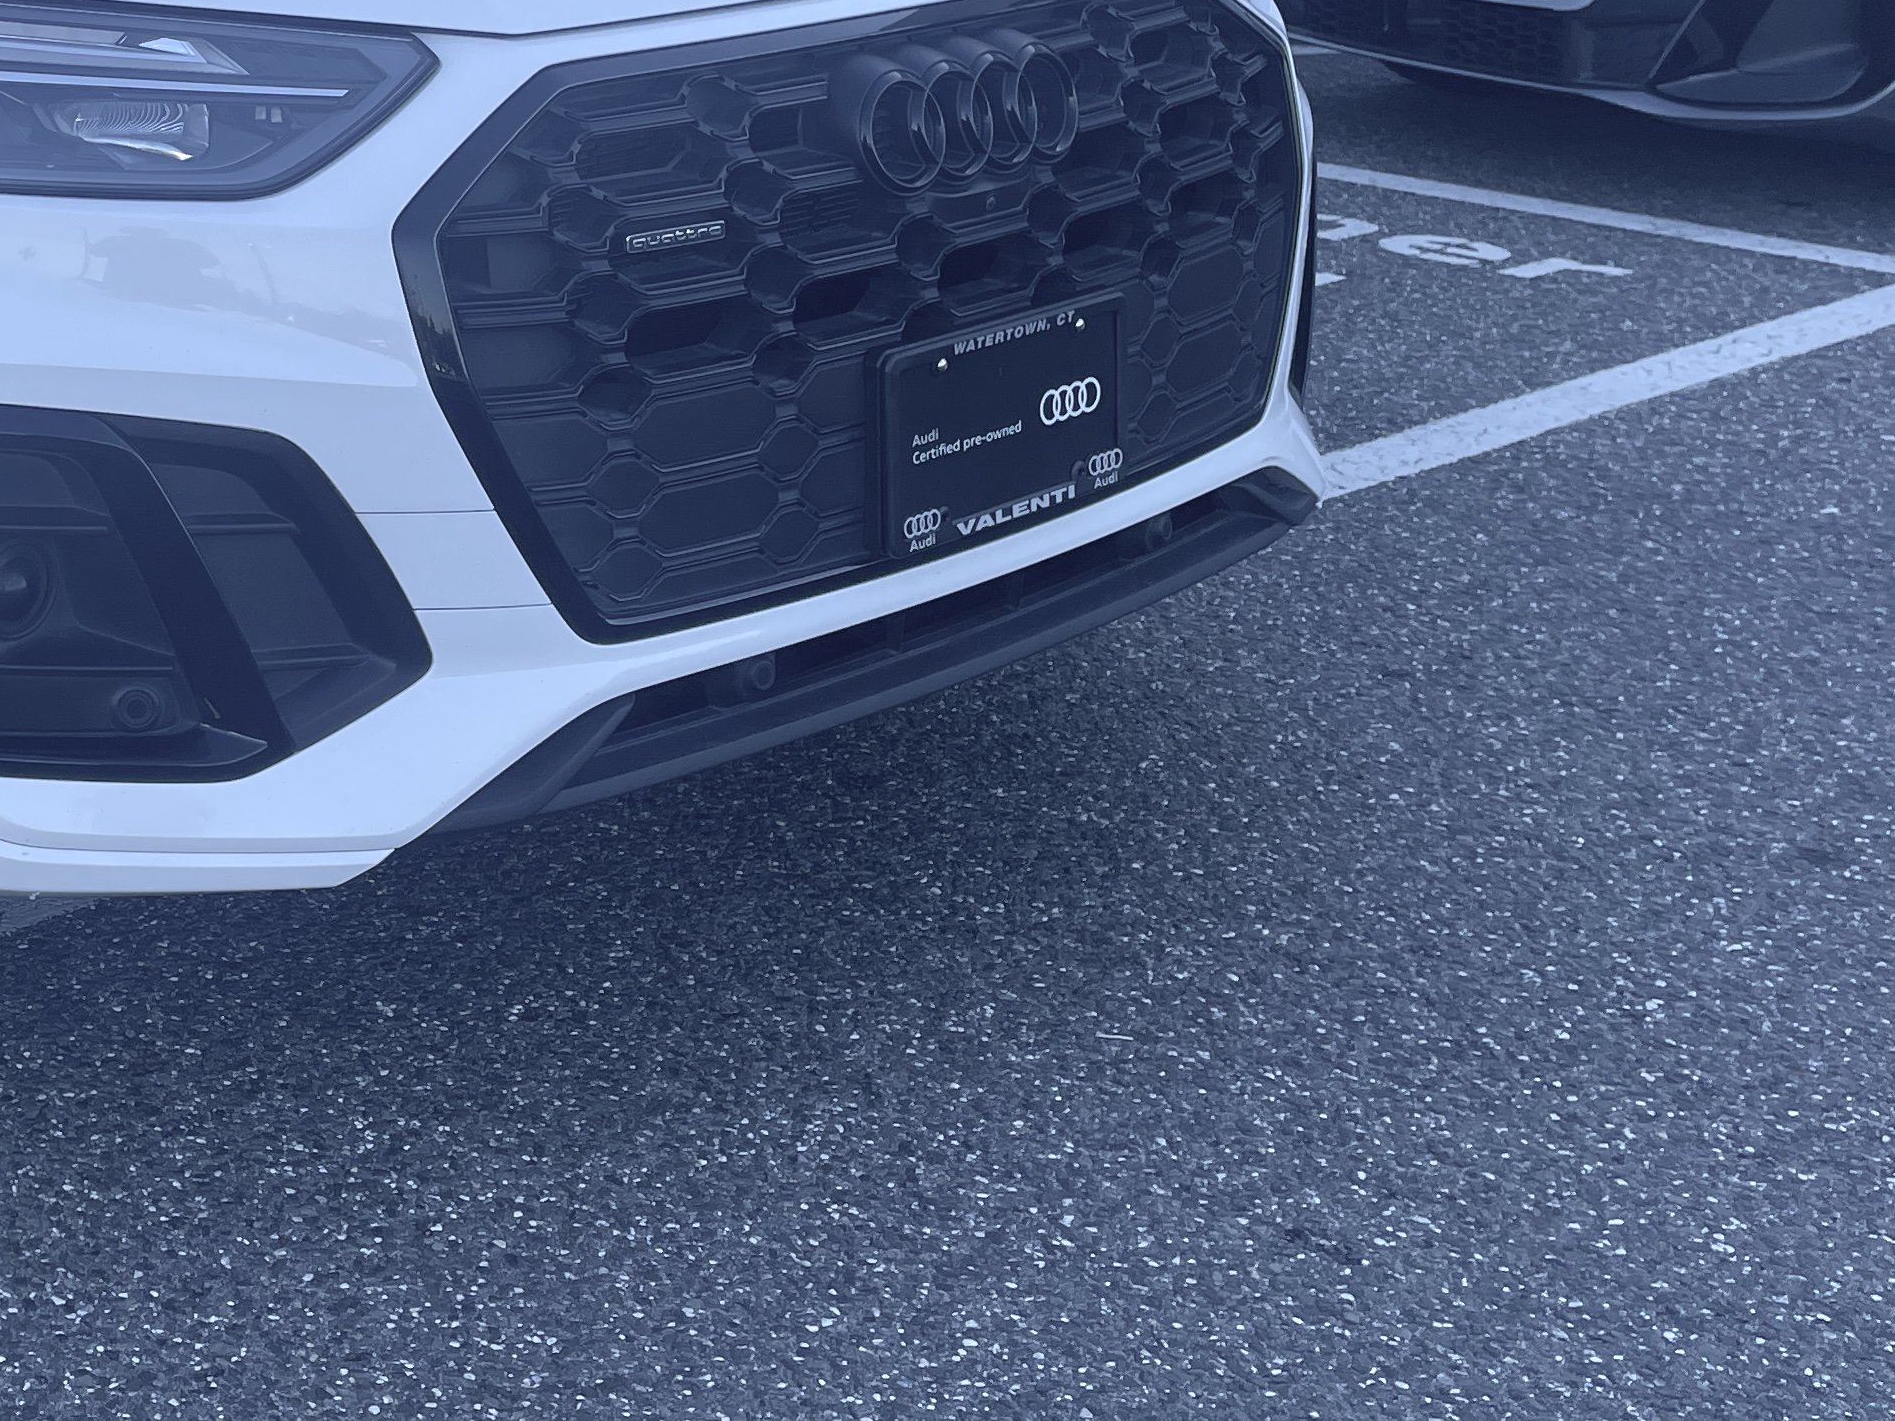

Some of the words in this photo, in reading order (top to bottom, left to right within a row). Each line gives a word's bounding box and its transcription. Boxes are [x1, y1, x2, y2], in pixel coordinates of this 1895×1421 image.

[632, 225, 722, 250] quattro
[953, 318, 1051, 356] WATERTOWN,
[1056, 310, 1076, 326] CT
[911, 427, 940, 448] Audi
[912, 439, 961, 465] Certified
[963, 419, 1023, 452] pre-owned
[1093, 471, 1119, 490] Audi
[956, 484, 1076, 536] VALENTI
[909, 532, 936, 553] Audi
